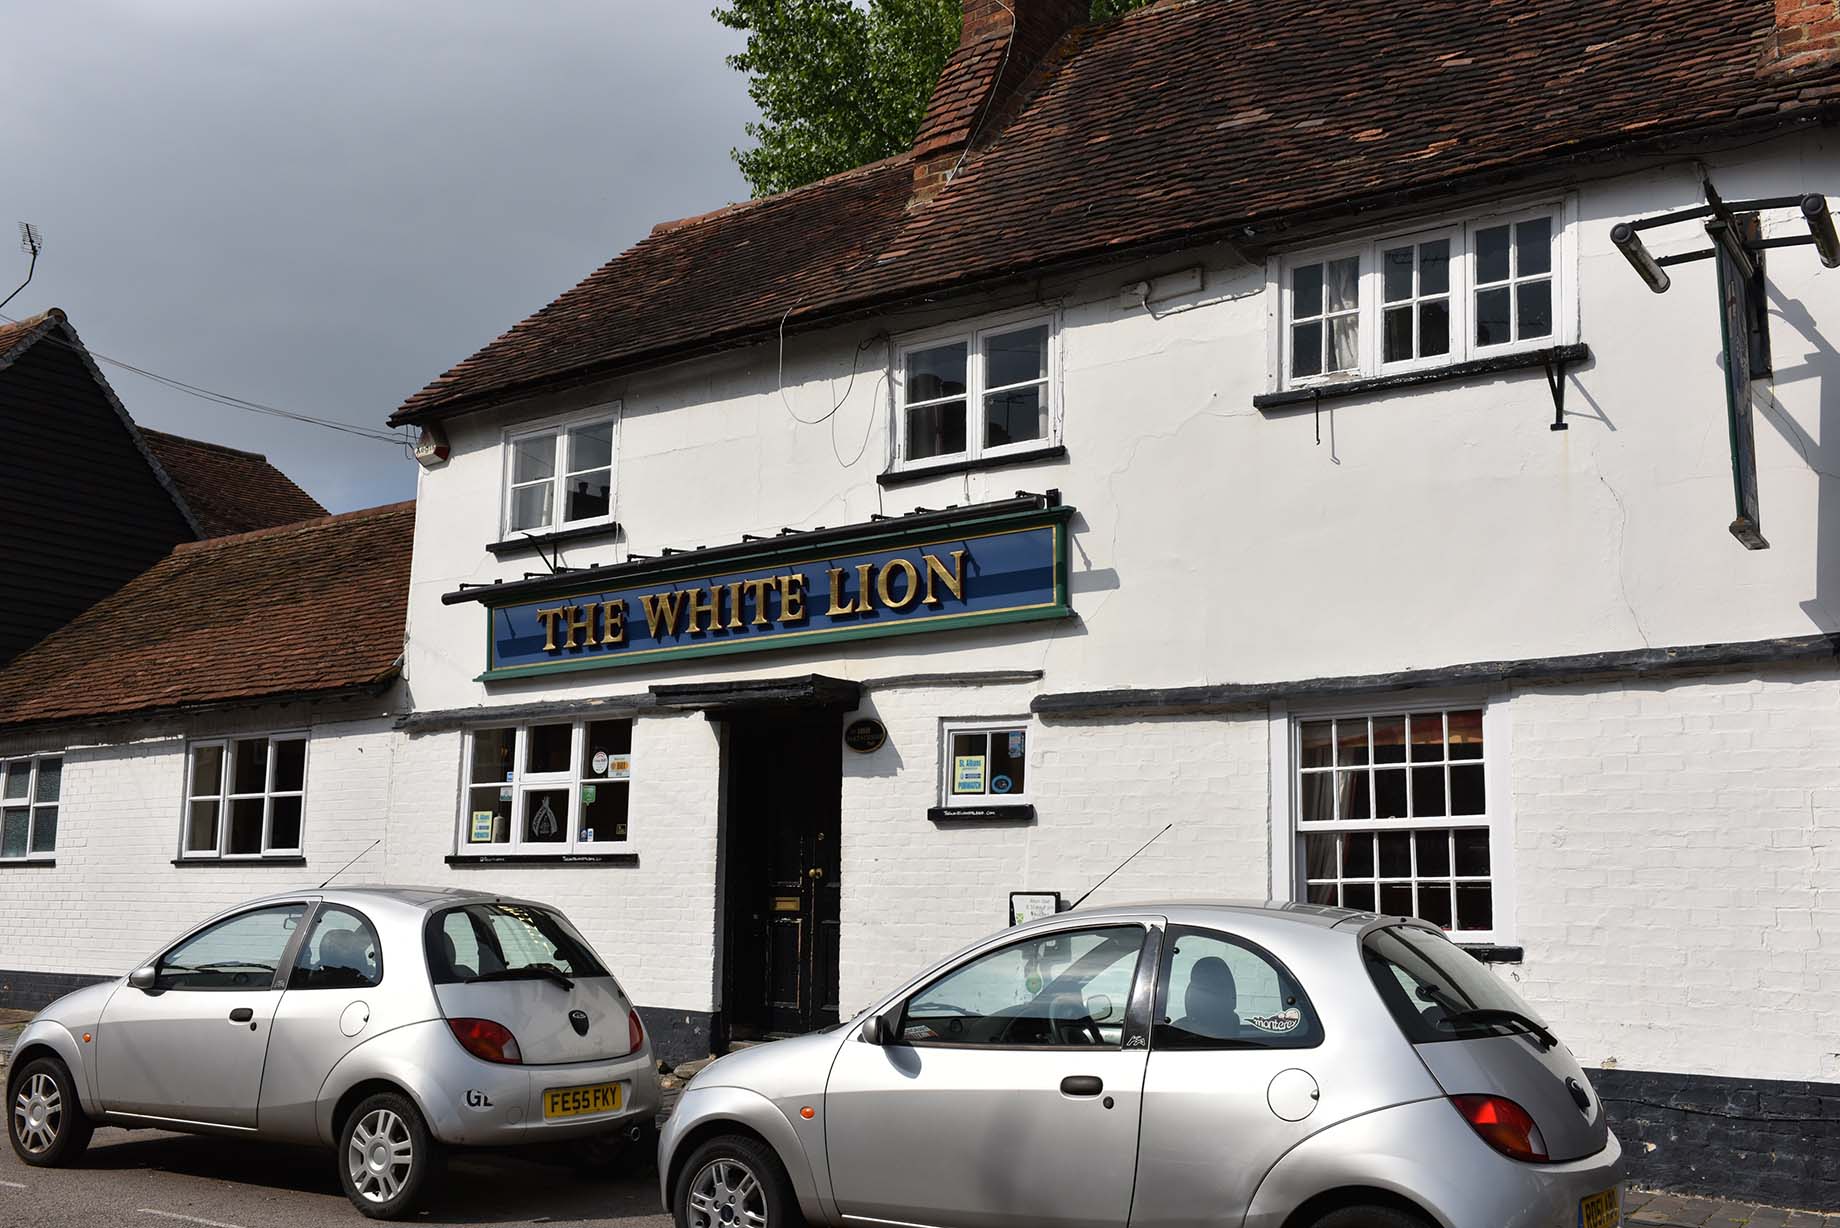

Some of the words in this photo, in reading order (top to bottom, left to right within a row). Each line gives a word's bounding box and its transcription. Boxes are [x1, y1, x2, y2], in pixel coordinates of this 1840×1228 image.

[536, 599, 626, 651] THE
[639, 573, 805, 638] WHITE
[824, 550, 968, 617] LION
[551, 1090, 591, 1113] FE55
[593, 1086, 617, 1108] FKY
